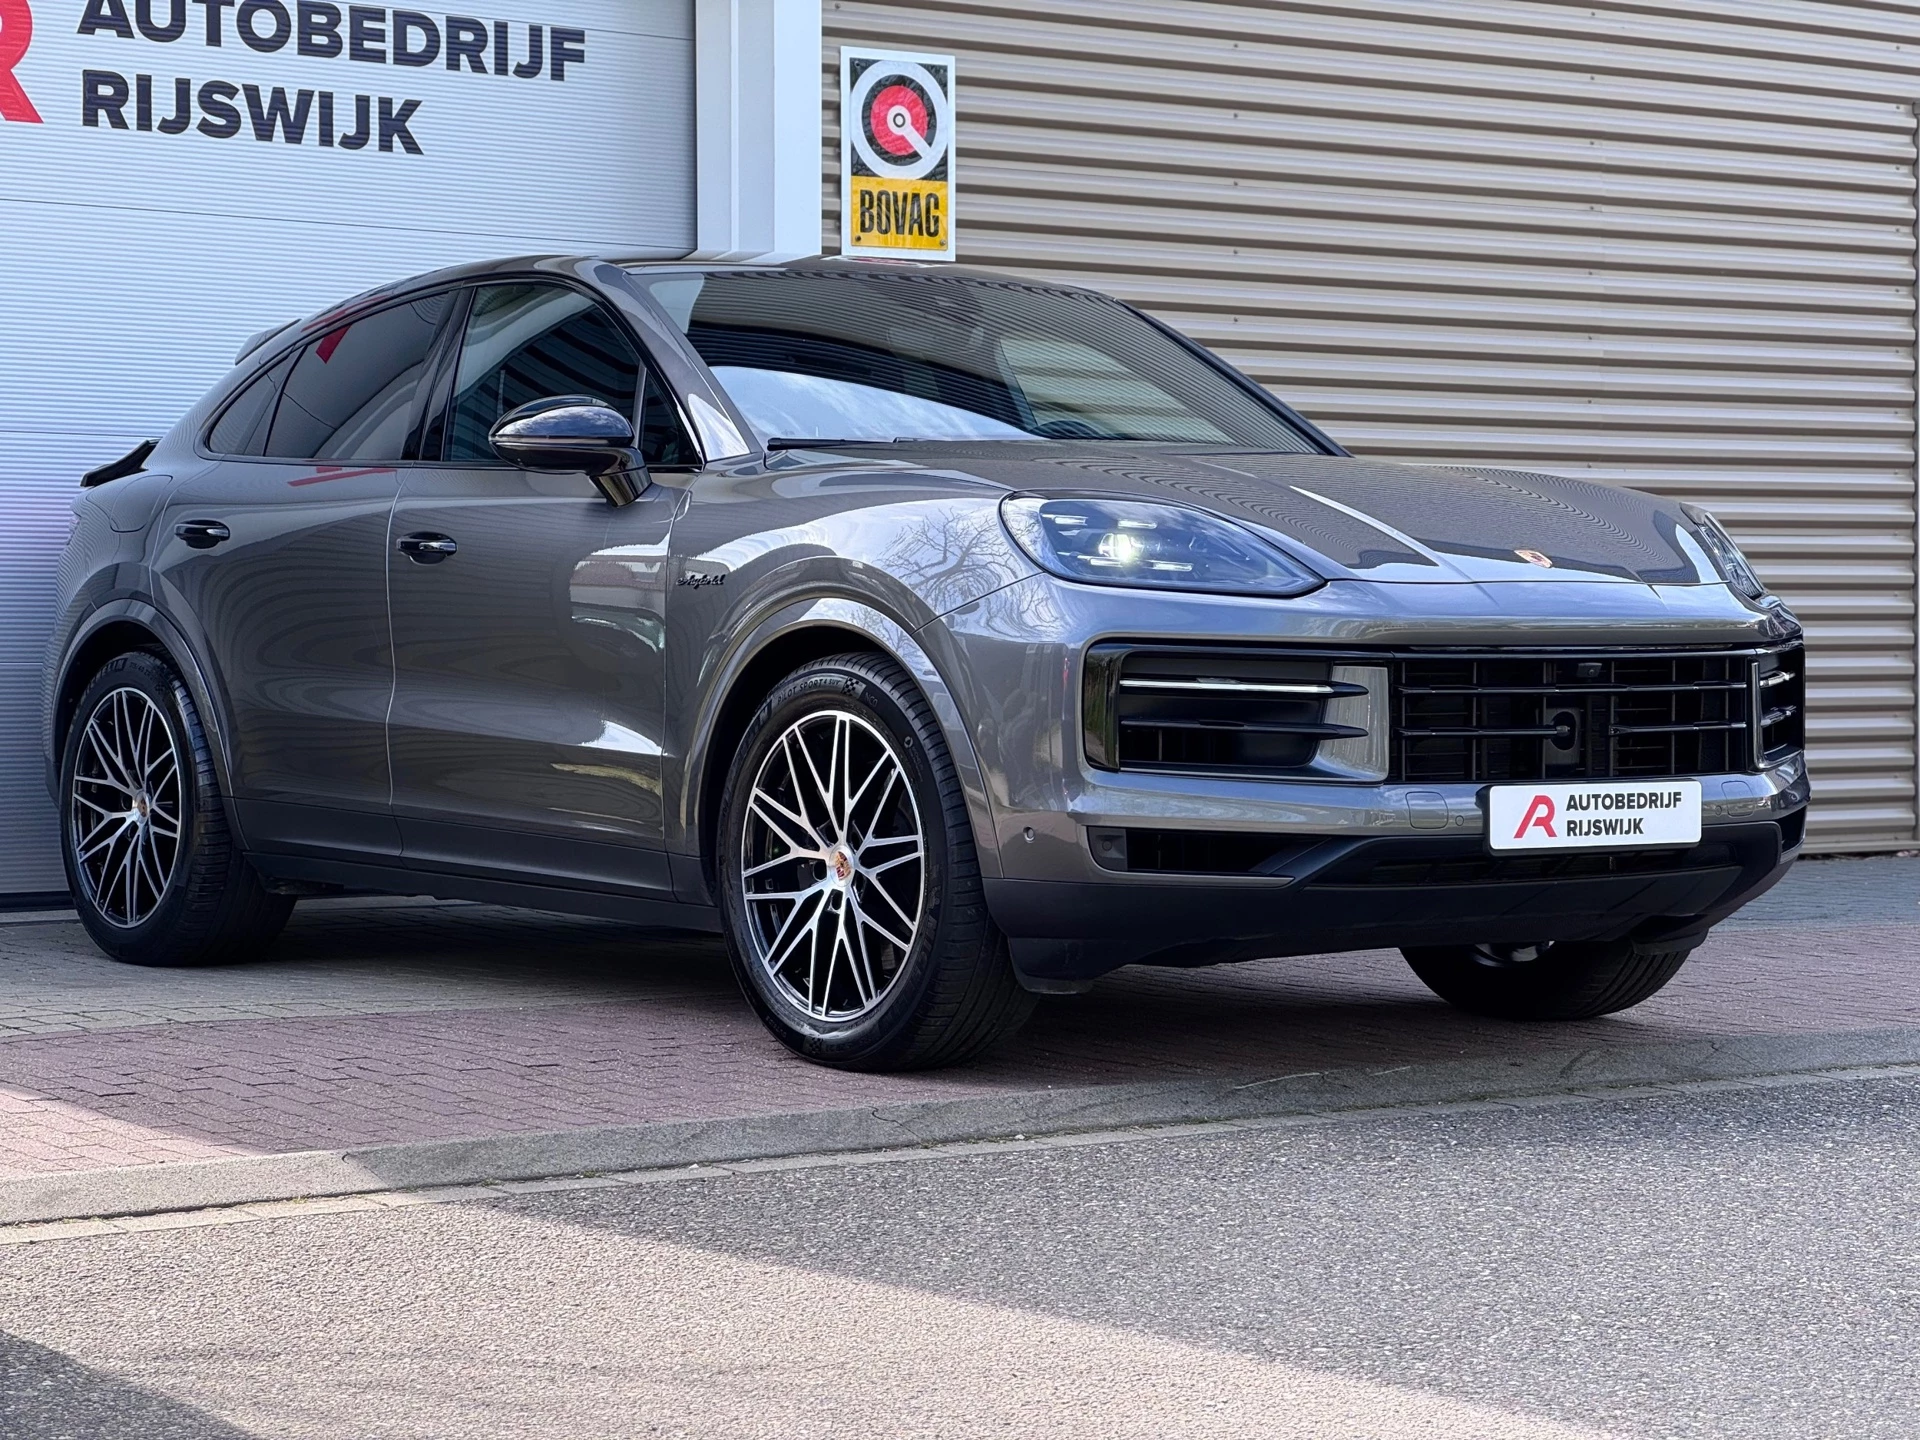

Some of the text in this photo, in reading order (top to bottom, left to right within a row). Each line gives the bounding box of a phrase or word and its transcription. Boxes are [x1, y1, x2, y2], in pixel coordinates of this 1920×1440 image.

[77, 0, 585, 82] AUTOBEDRIJF
[82, 69, 425, 155] RIJSWIJK
[859, 189, 940, 238] BOVAG
[777, 685, 797, 705] PILOT
[799, 679, 823, 691] SPORT
[1566, 791, 1682, 811] AUTOBEDRIJF
[1566, 818, 1644, 837] RIJSWIJK
